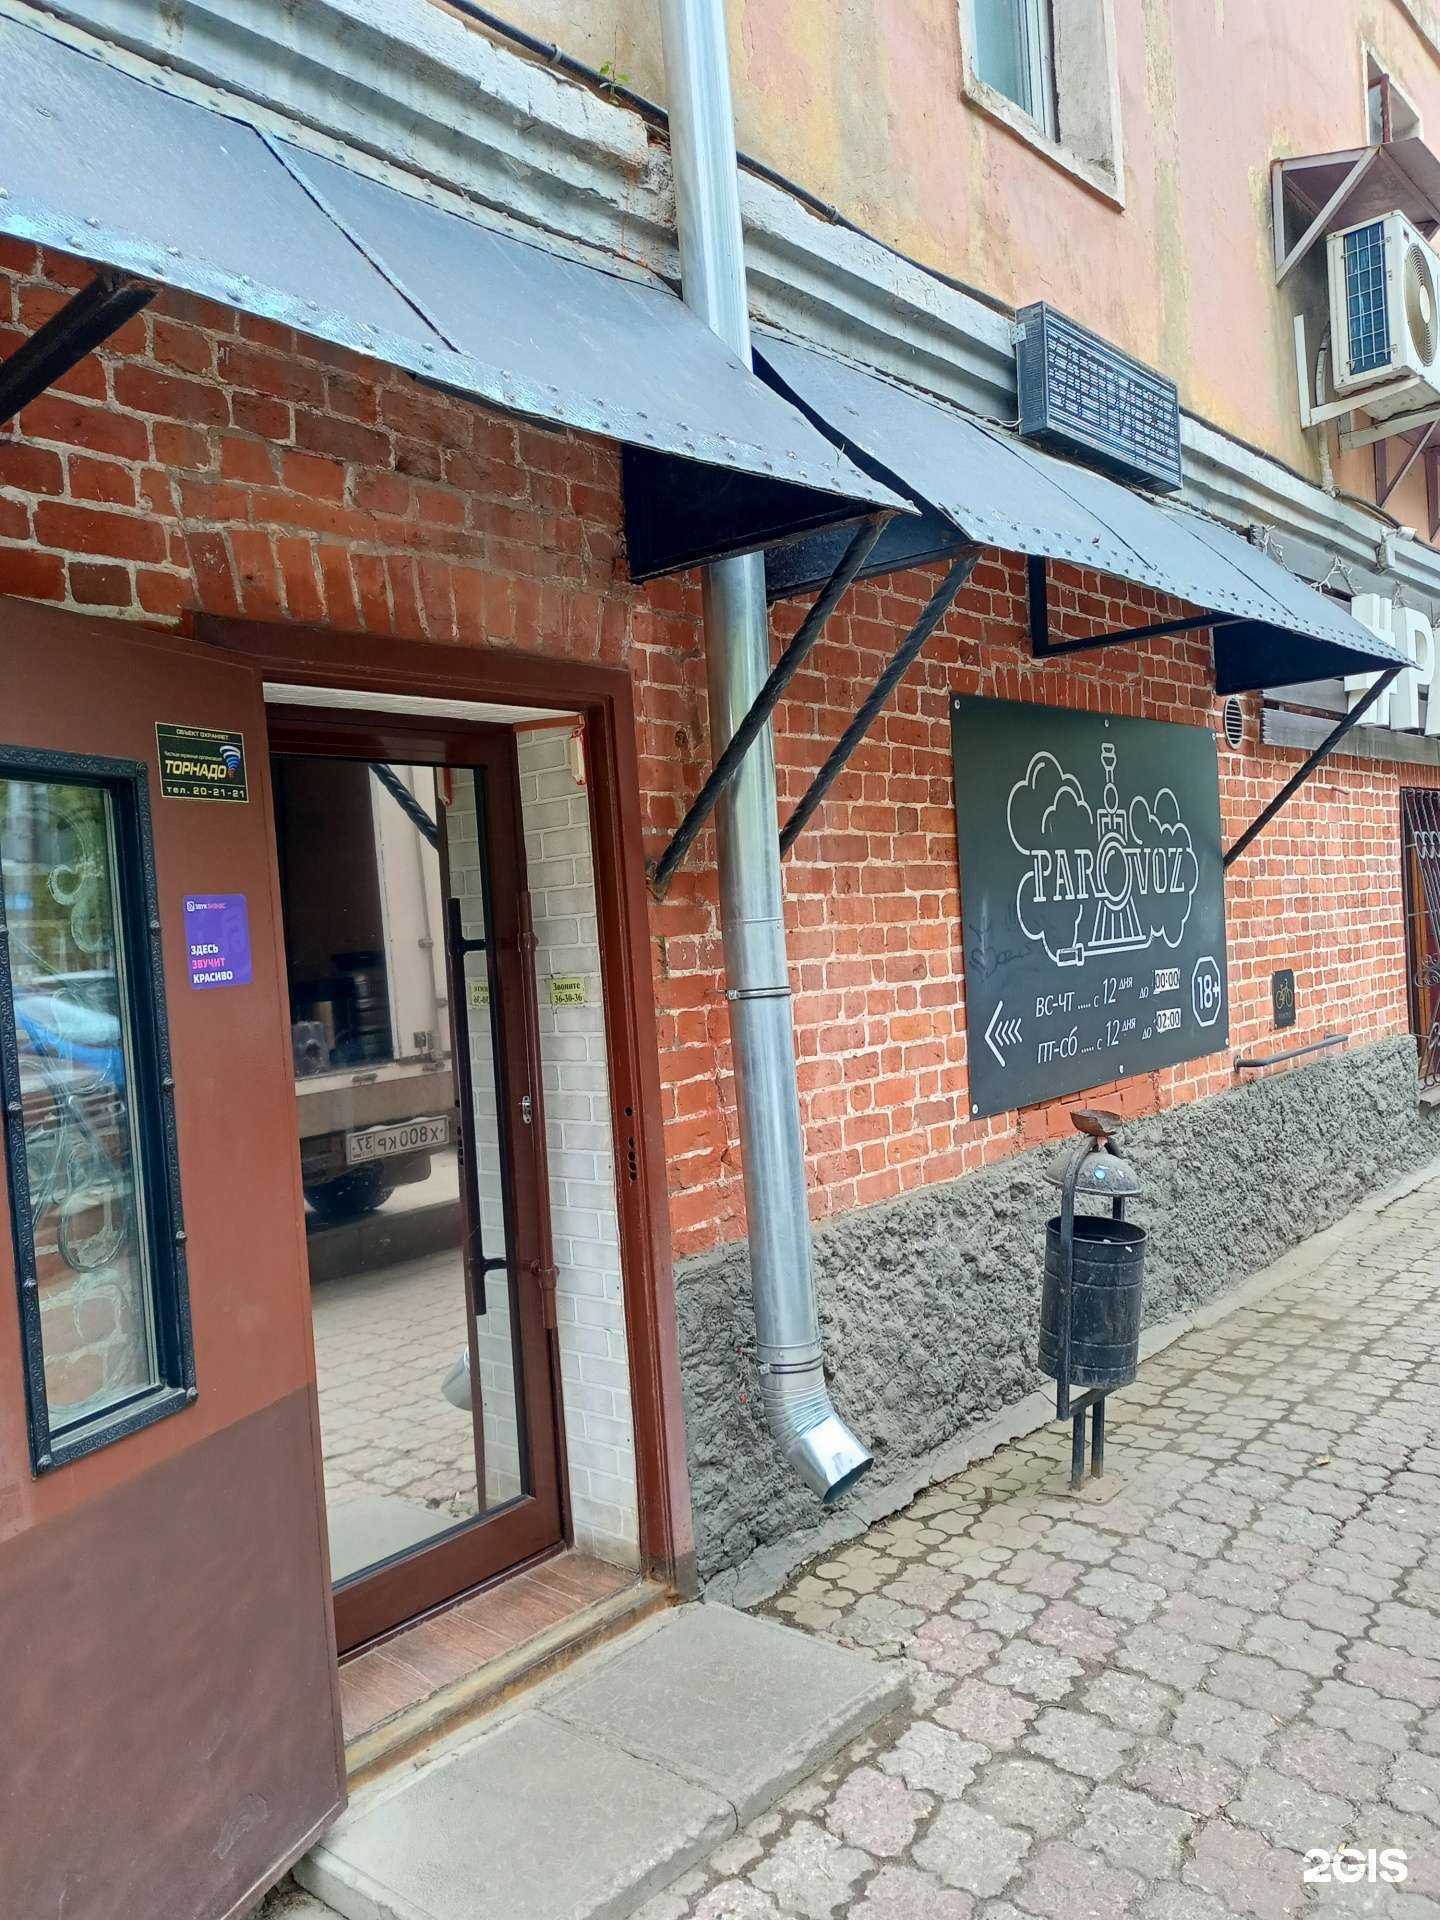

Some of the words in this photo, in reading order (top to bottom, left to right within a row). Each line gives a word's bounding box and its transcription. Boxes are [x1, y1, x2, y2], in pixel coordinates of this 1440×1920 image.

[165, 760, 227, 780] ТОРНАДО
[167, 786, 190, 794] тел.
[192, 786, 245, 798] 20-21-21
[1031, 841, 1185, 903] PAROVOZ
[190, 944, 219, 956] ЗДЕСЬ
[192, 957, 225, 969] ЗВУЧИТ
[193, 970, 233, 984] КРАСИВО
[1035, 992, 1075, 1018] ВС-ЧТ
[1102, 977, 1117, 1005] 12
[1197, 974, 1220, 1010] 18+
[1105, 1019, 1120, 1047] 12
